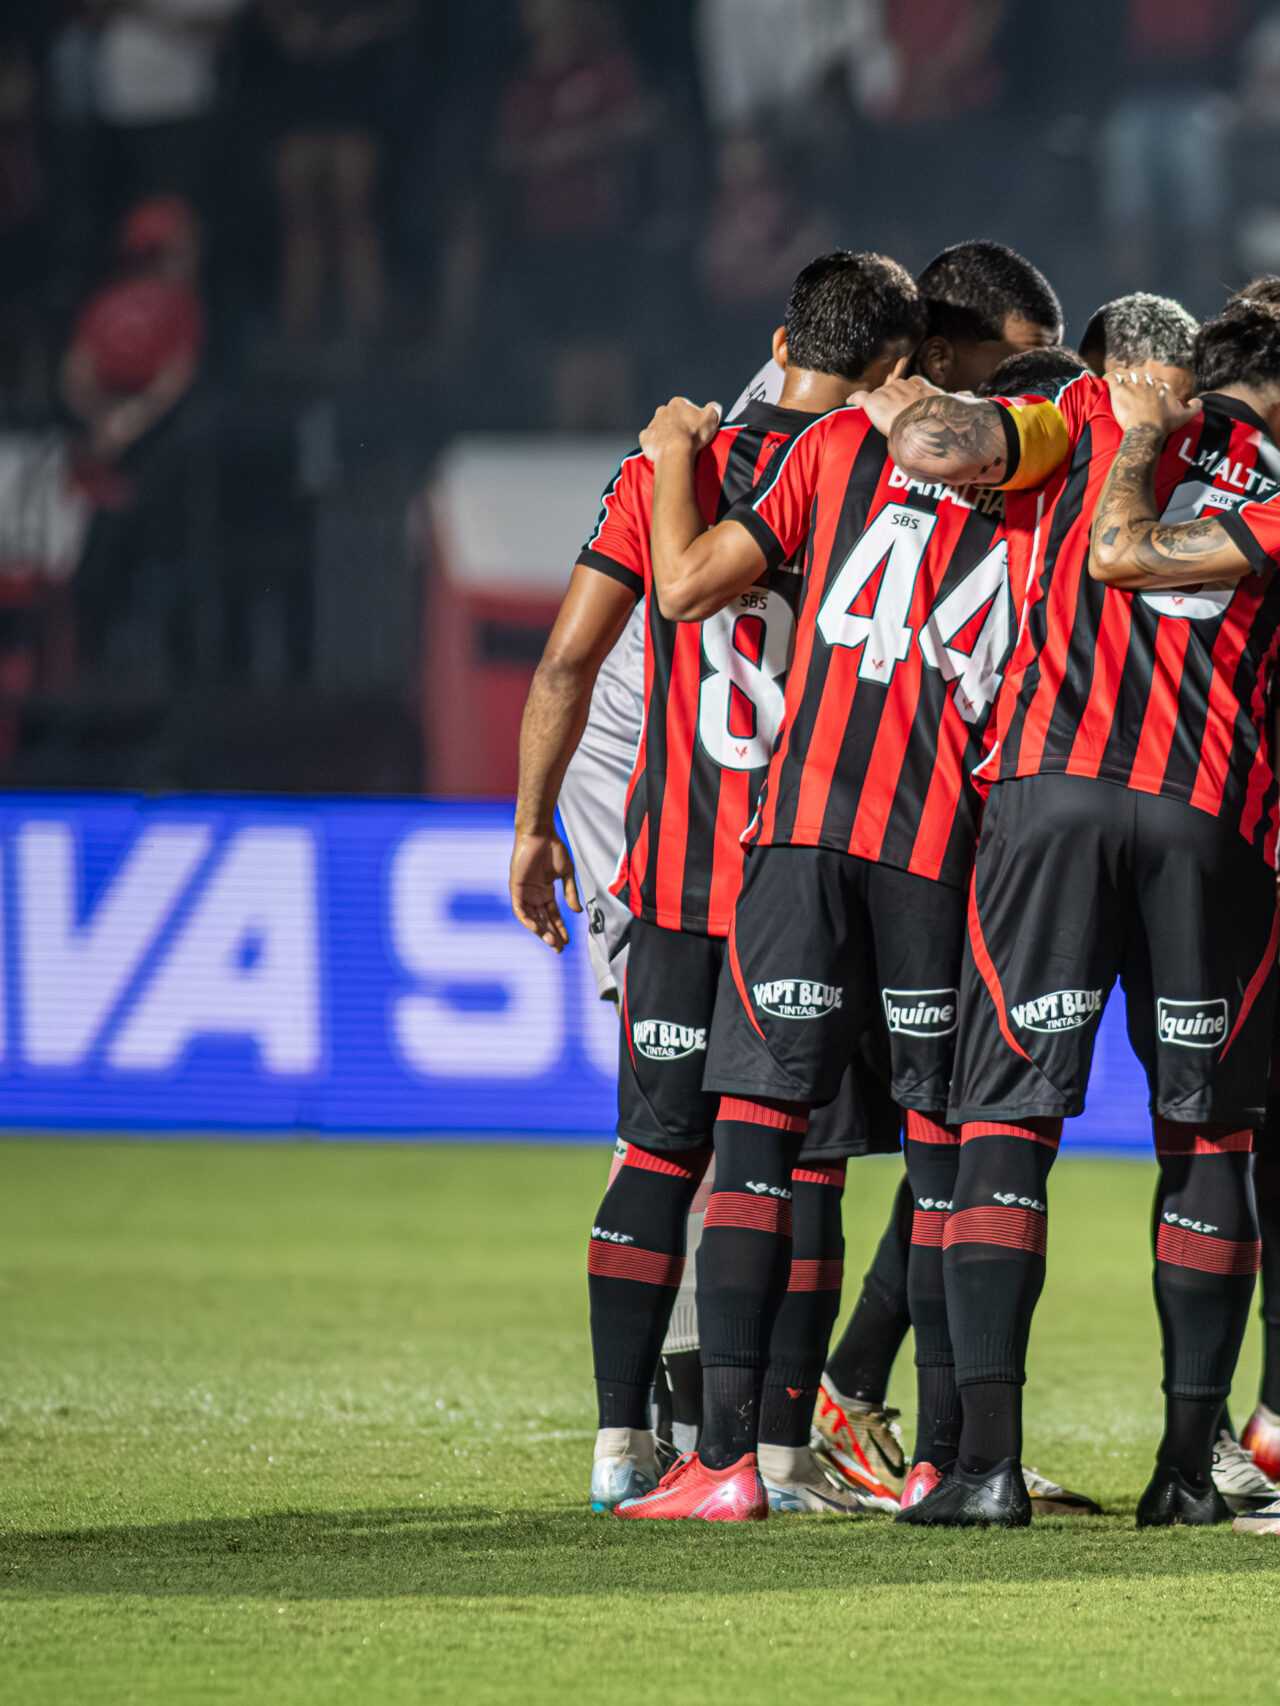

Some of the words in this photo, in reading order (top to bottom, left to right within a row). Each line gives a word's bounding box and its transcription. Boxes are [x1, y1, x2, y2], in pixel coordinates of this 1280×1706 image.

[890, 513, 920, 530] SBS
[740, 593, 767, 610] SBS
[699, 585, 796, 770] 8
[778, 1005, 818, 1016] TINTAS
[1045, 1015, 1083, 1030] TINTAS
